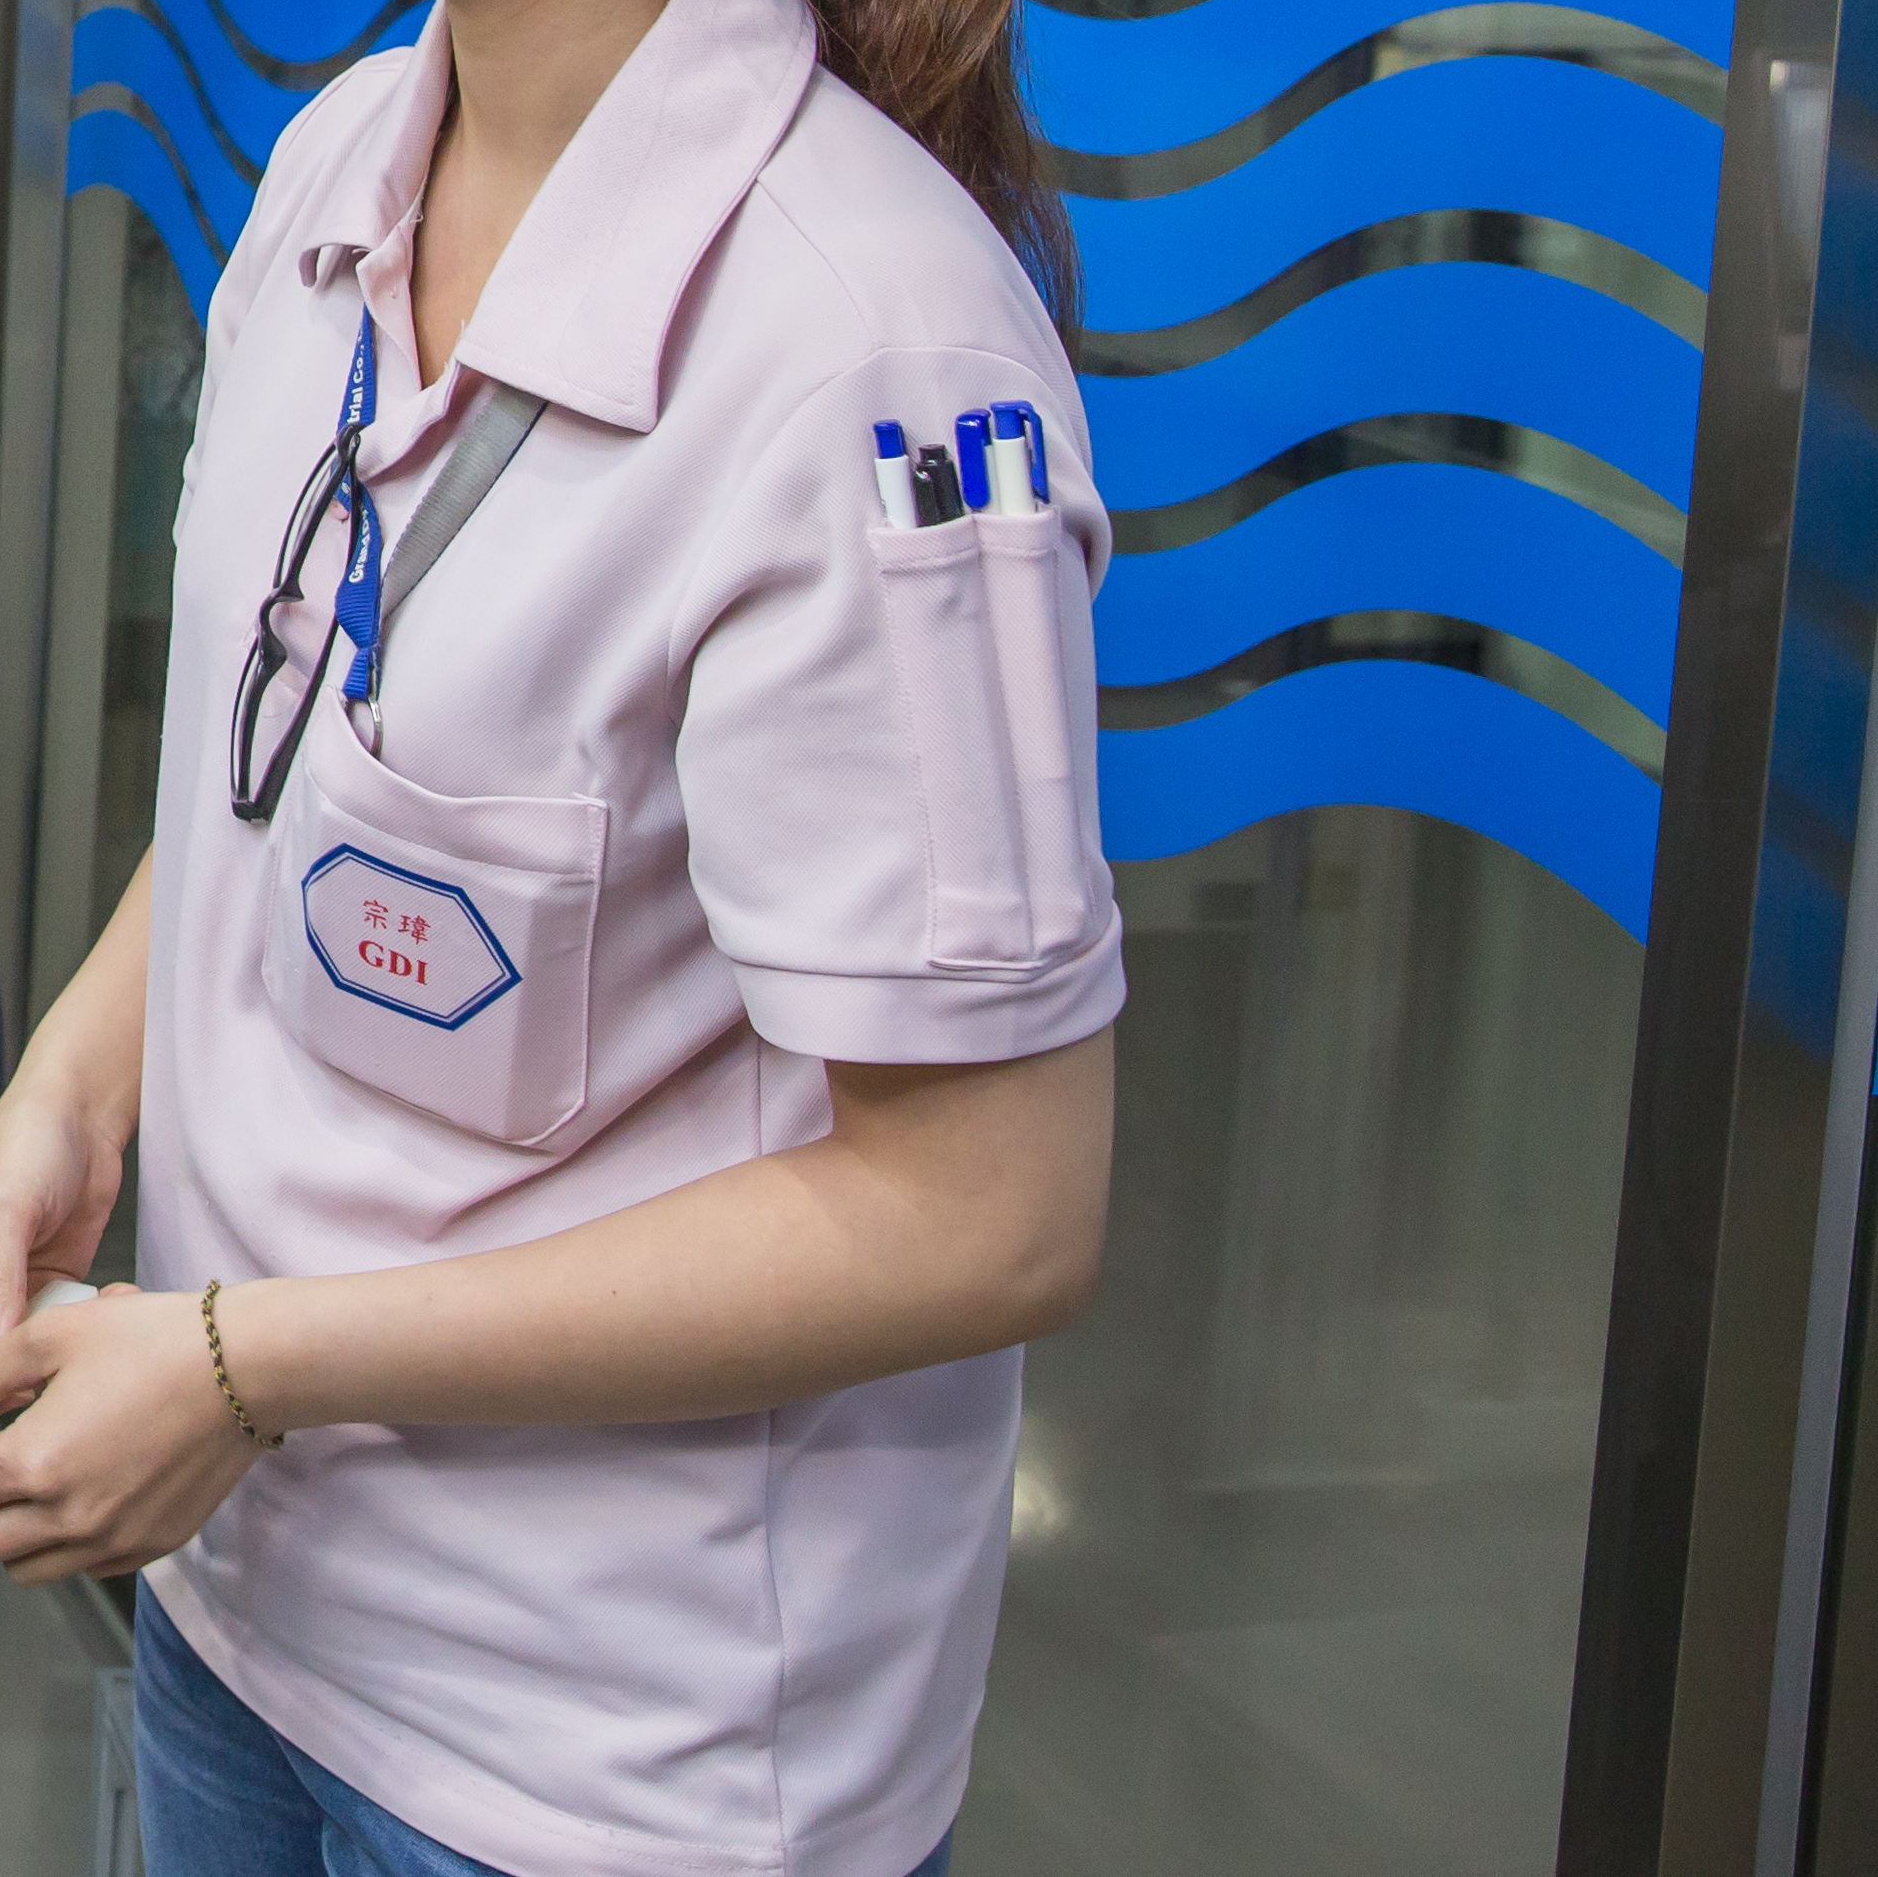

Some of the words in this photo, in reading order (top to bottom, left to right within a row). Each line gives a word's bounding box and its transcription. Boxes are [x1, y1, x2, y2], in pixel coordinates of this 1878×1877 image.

[347, 386, 364, 424] trial
[348, 534, 371, 584] Grand
[362, 899, 432, 946] 宗瑋
[358, 939, 428, 986] GDI
